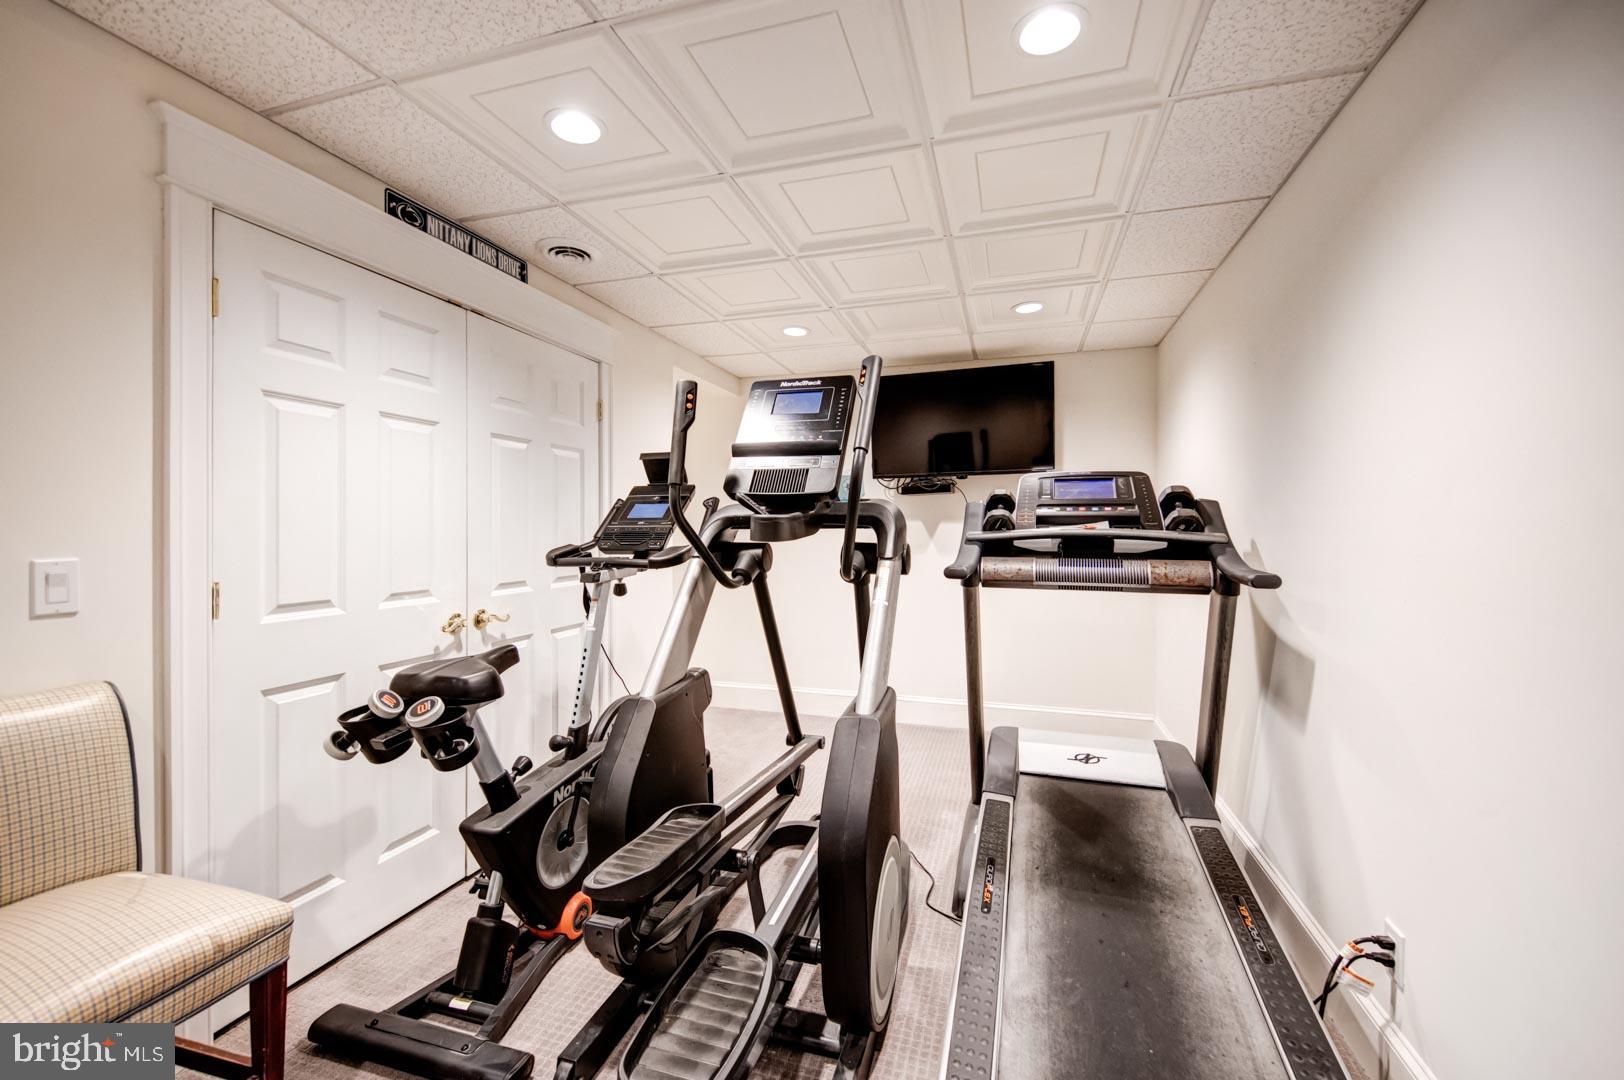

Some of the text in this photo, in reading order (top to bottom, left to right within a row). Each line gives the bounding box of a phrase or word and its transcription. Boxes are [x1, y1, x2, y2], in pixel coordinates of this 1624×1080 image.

[426, 213, 522, 279] NITTANY LIONS DRIVE
[780, 380, 823, 388] NordicTrack
